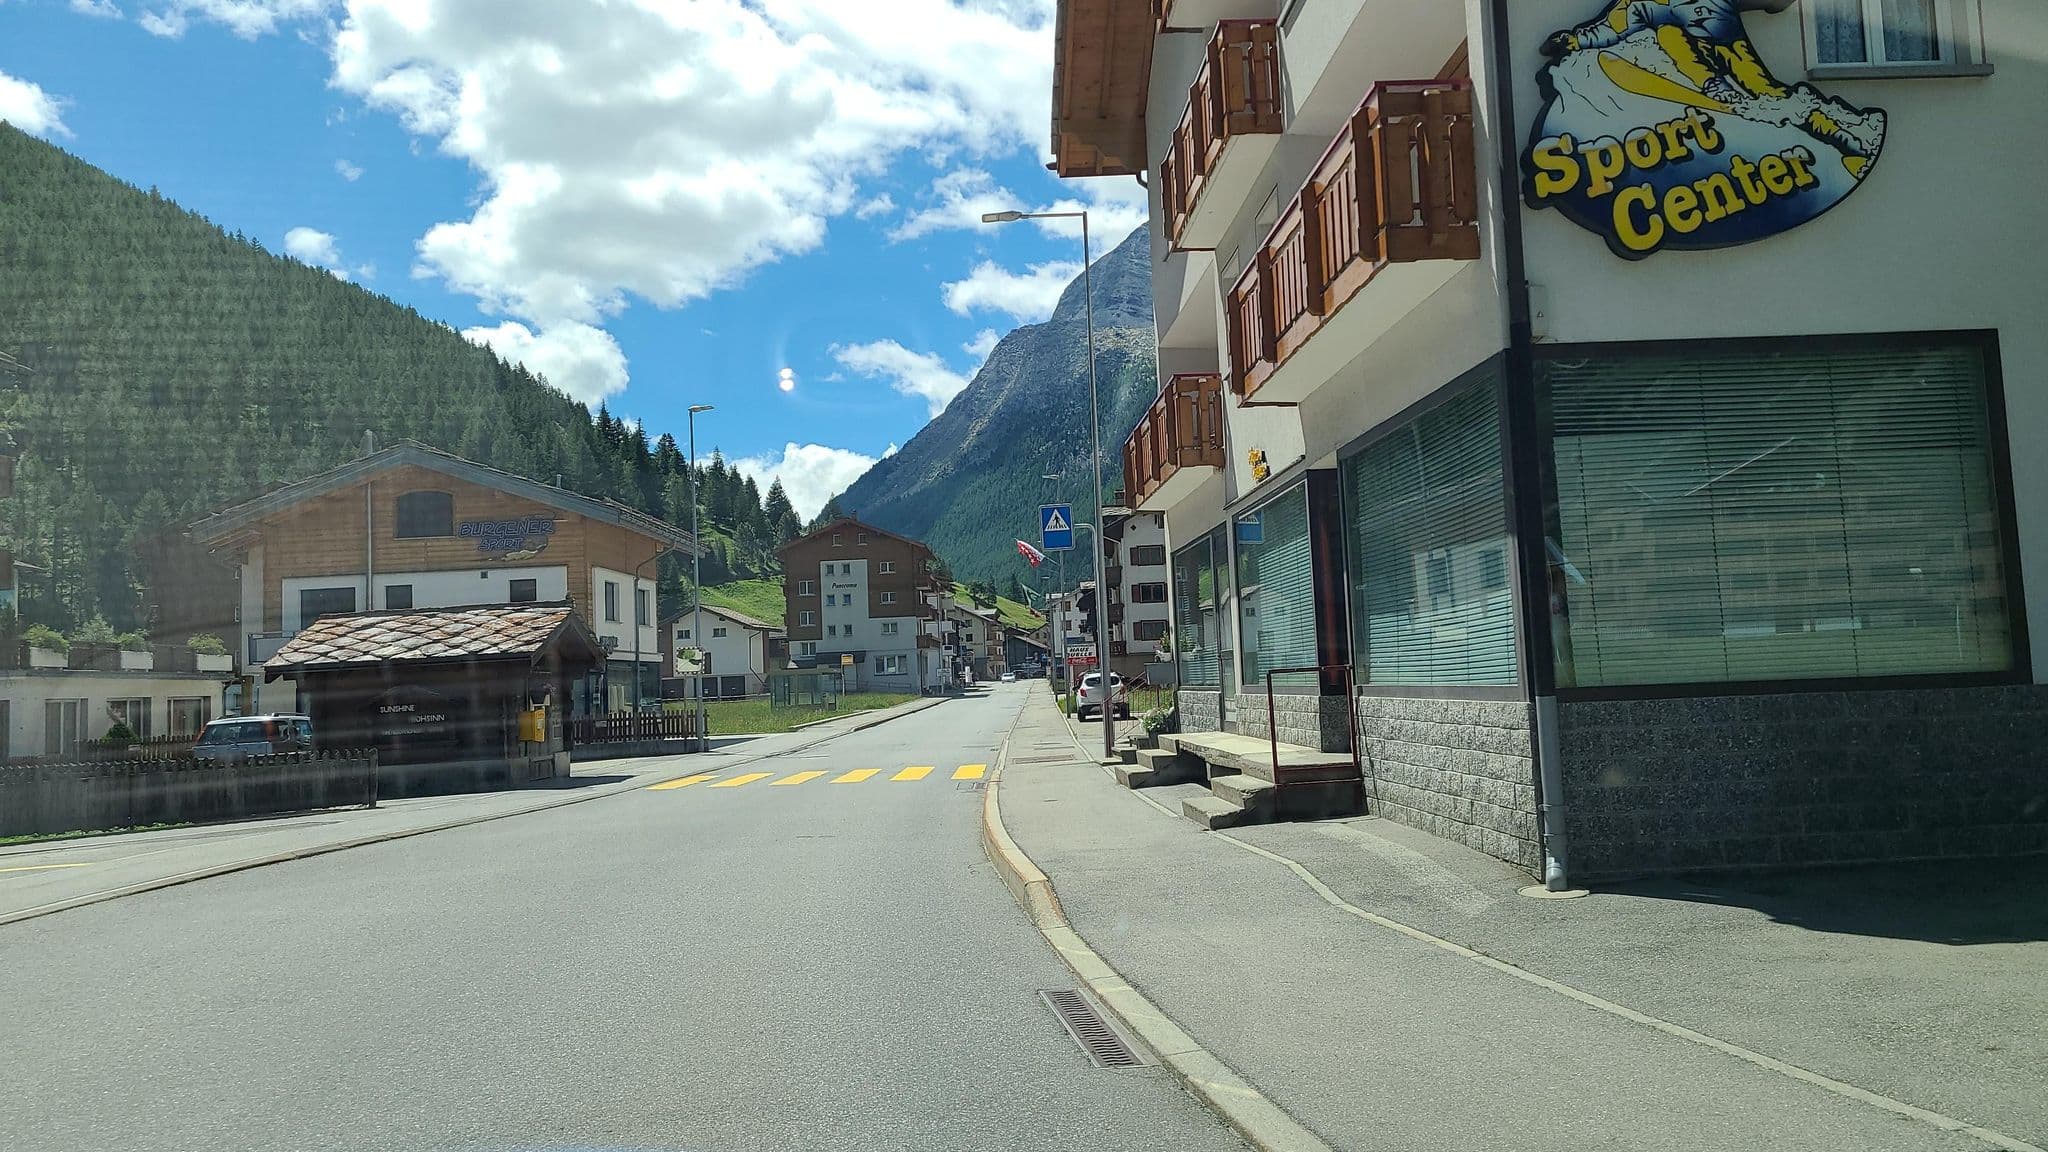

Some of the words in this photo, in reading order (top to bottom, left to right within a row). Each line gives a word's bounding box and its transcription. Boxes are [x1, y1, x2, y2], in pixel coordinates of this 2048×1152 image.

[1532, 107, 1721, 198] Sport
[1612, 144, 1816, 251] Center
[460, 519, 554, 537] BURGENER
[478, 537, 523, 551] SPORT
[379, 704, 416, 714] SUNSHINE
[409, 714, 445, 724] OHSINN
